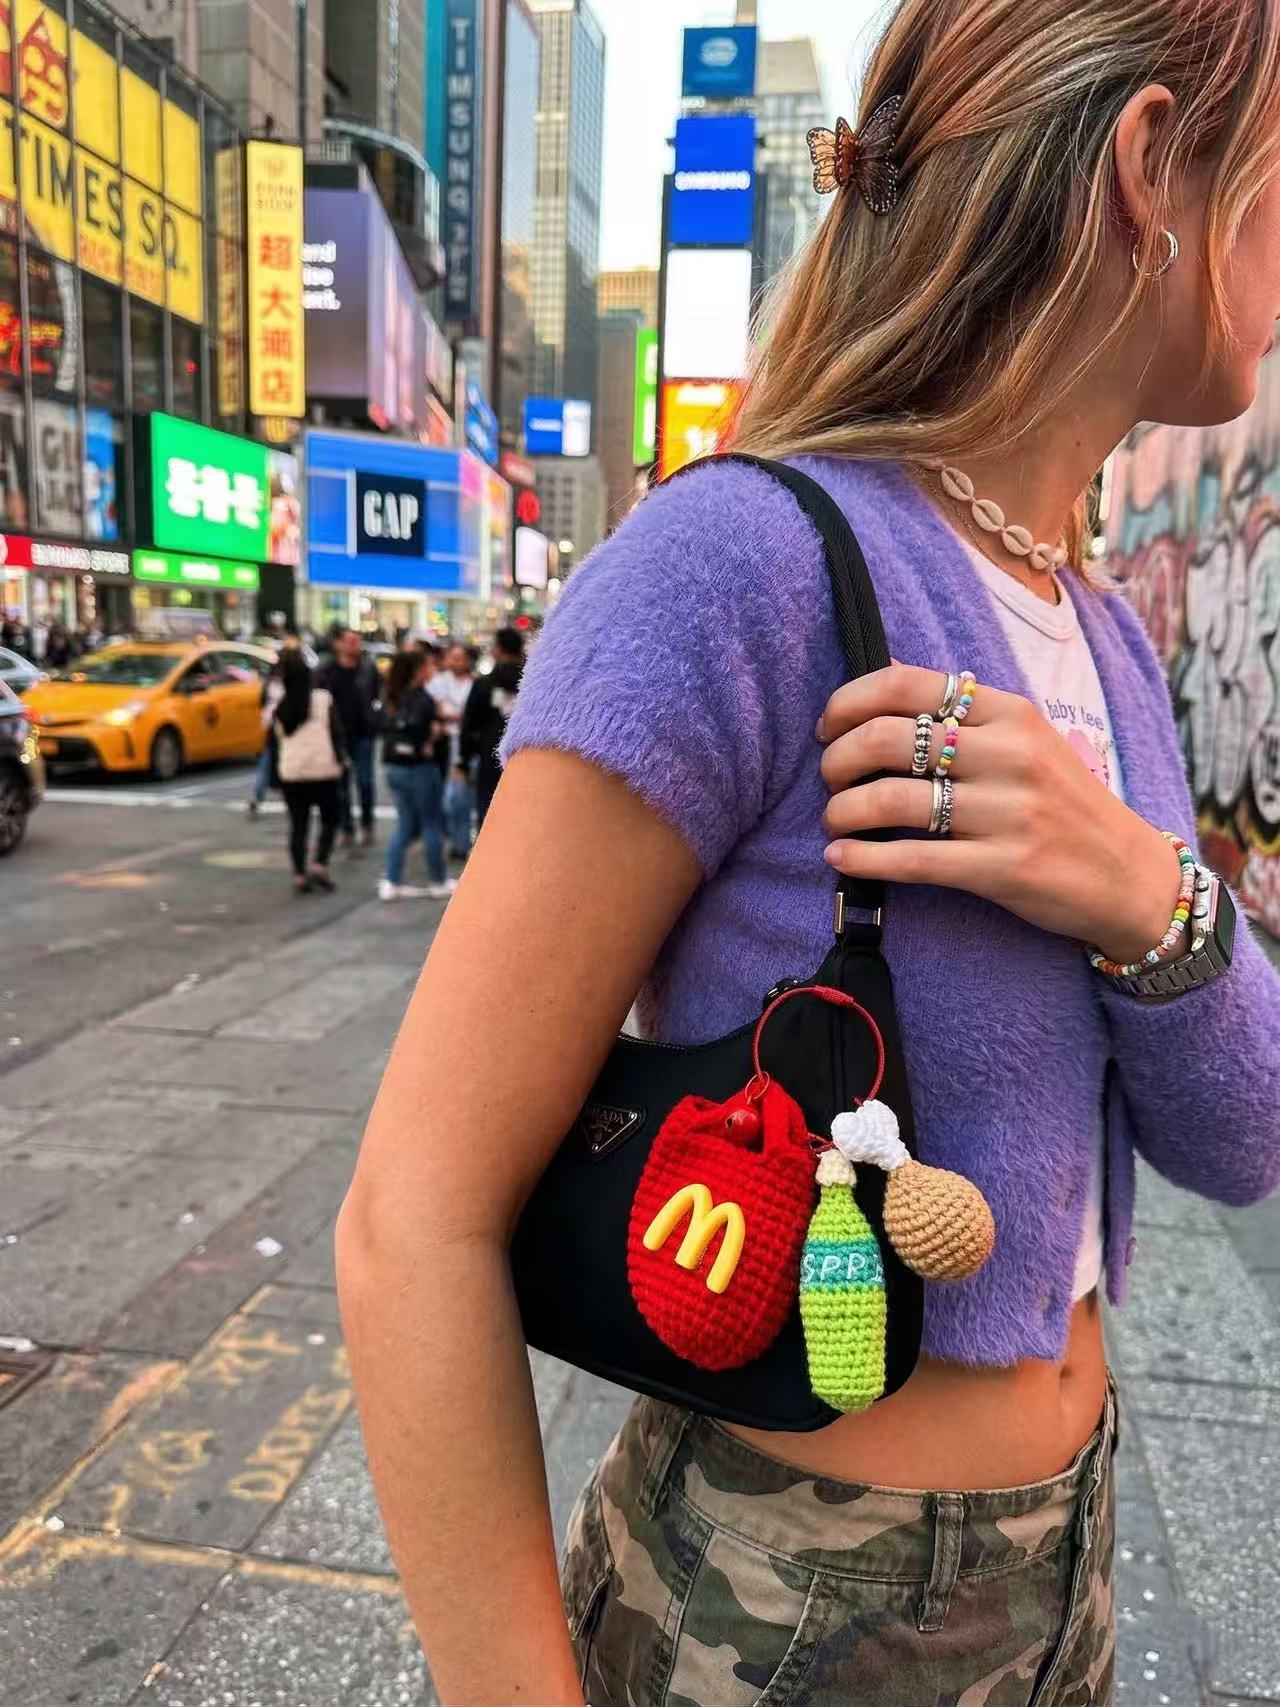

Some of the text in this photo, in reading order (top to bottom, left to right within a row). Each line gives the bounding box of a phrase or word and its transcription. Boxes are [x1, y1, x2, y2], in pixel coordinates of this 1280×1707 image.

[4, 114, 123, 242] TIMES
[364, 489, 419, 540] GAP
[1045, 698, 1104, 731] baby tee
[642, 1183, 746, 1295] M
